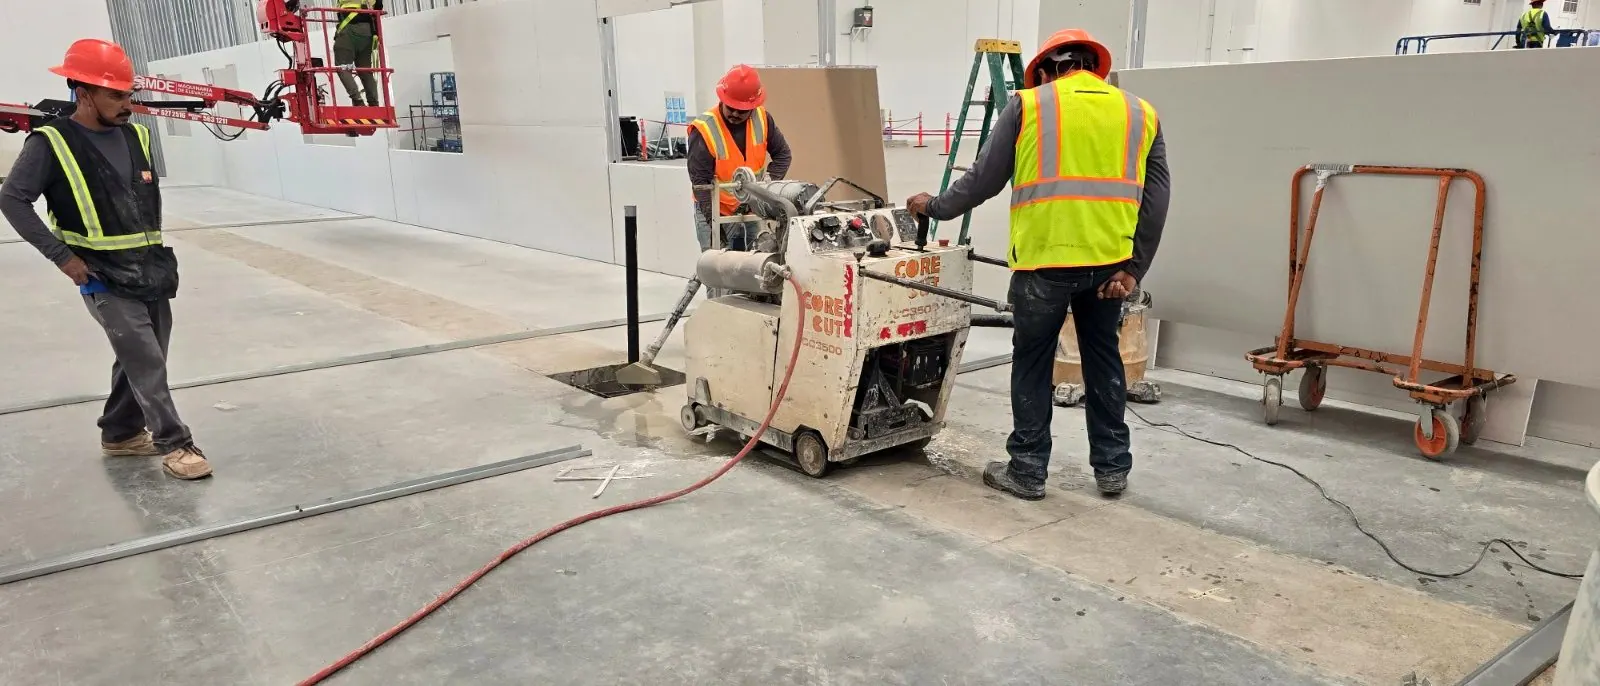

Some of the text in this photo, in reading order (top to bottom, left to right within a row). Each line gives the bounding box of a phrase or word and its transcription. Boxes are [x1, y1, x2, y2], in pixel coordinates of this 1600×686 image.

[146, 78, 175, 92] MDE
[895, 256, 940, 278] CORE
[802, 291, 843, 317] CORE
[812, 315, 843, 338] CUT
